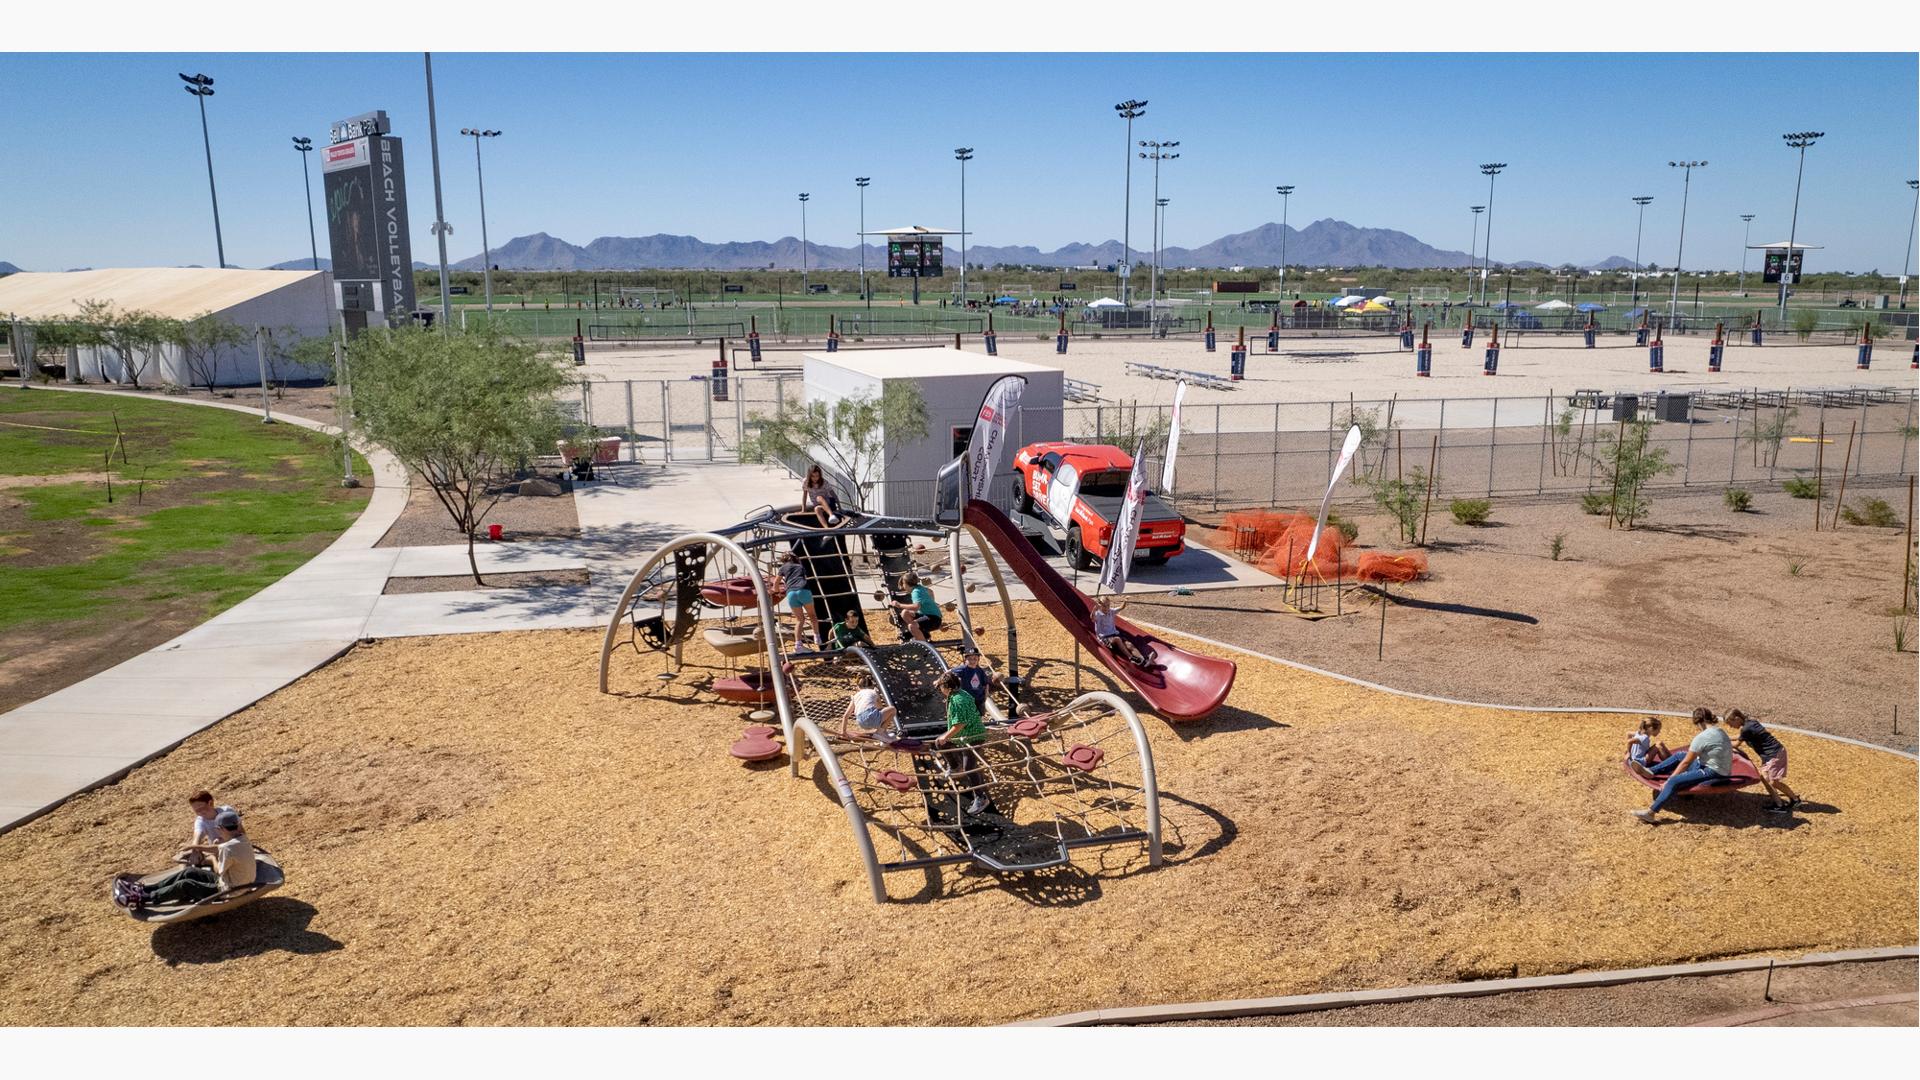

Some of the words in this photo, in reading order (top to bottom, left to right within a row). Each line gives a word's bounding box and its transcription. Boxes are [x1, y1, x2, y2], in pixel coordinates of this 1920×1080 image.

[347, 121, 364, 139] Bank
[363, 118, 377, 136] Park
[379, 139, 396, 202] BEACH
[385, 206, 405, 325] VOLLEYBALL
[972, 446, 985, 482] COURT
